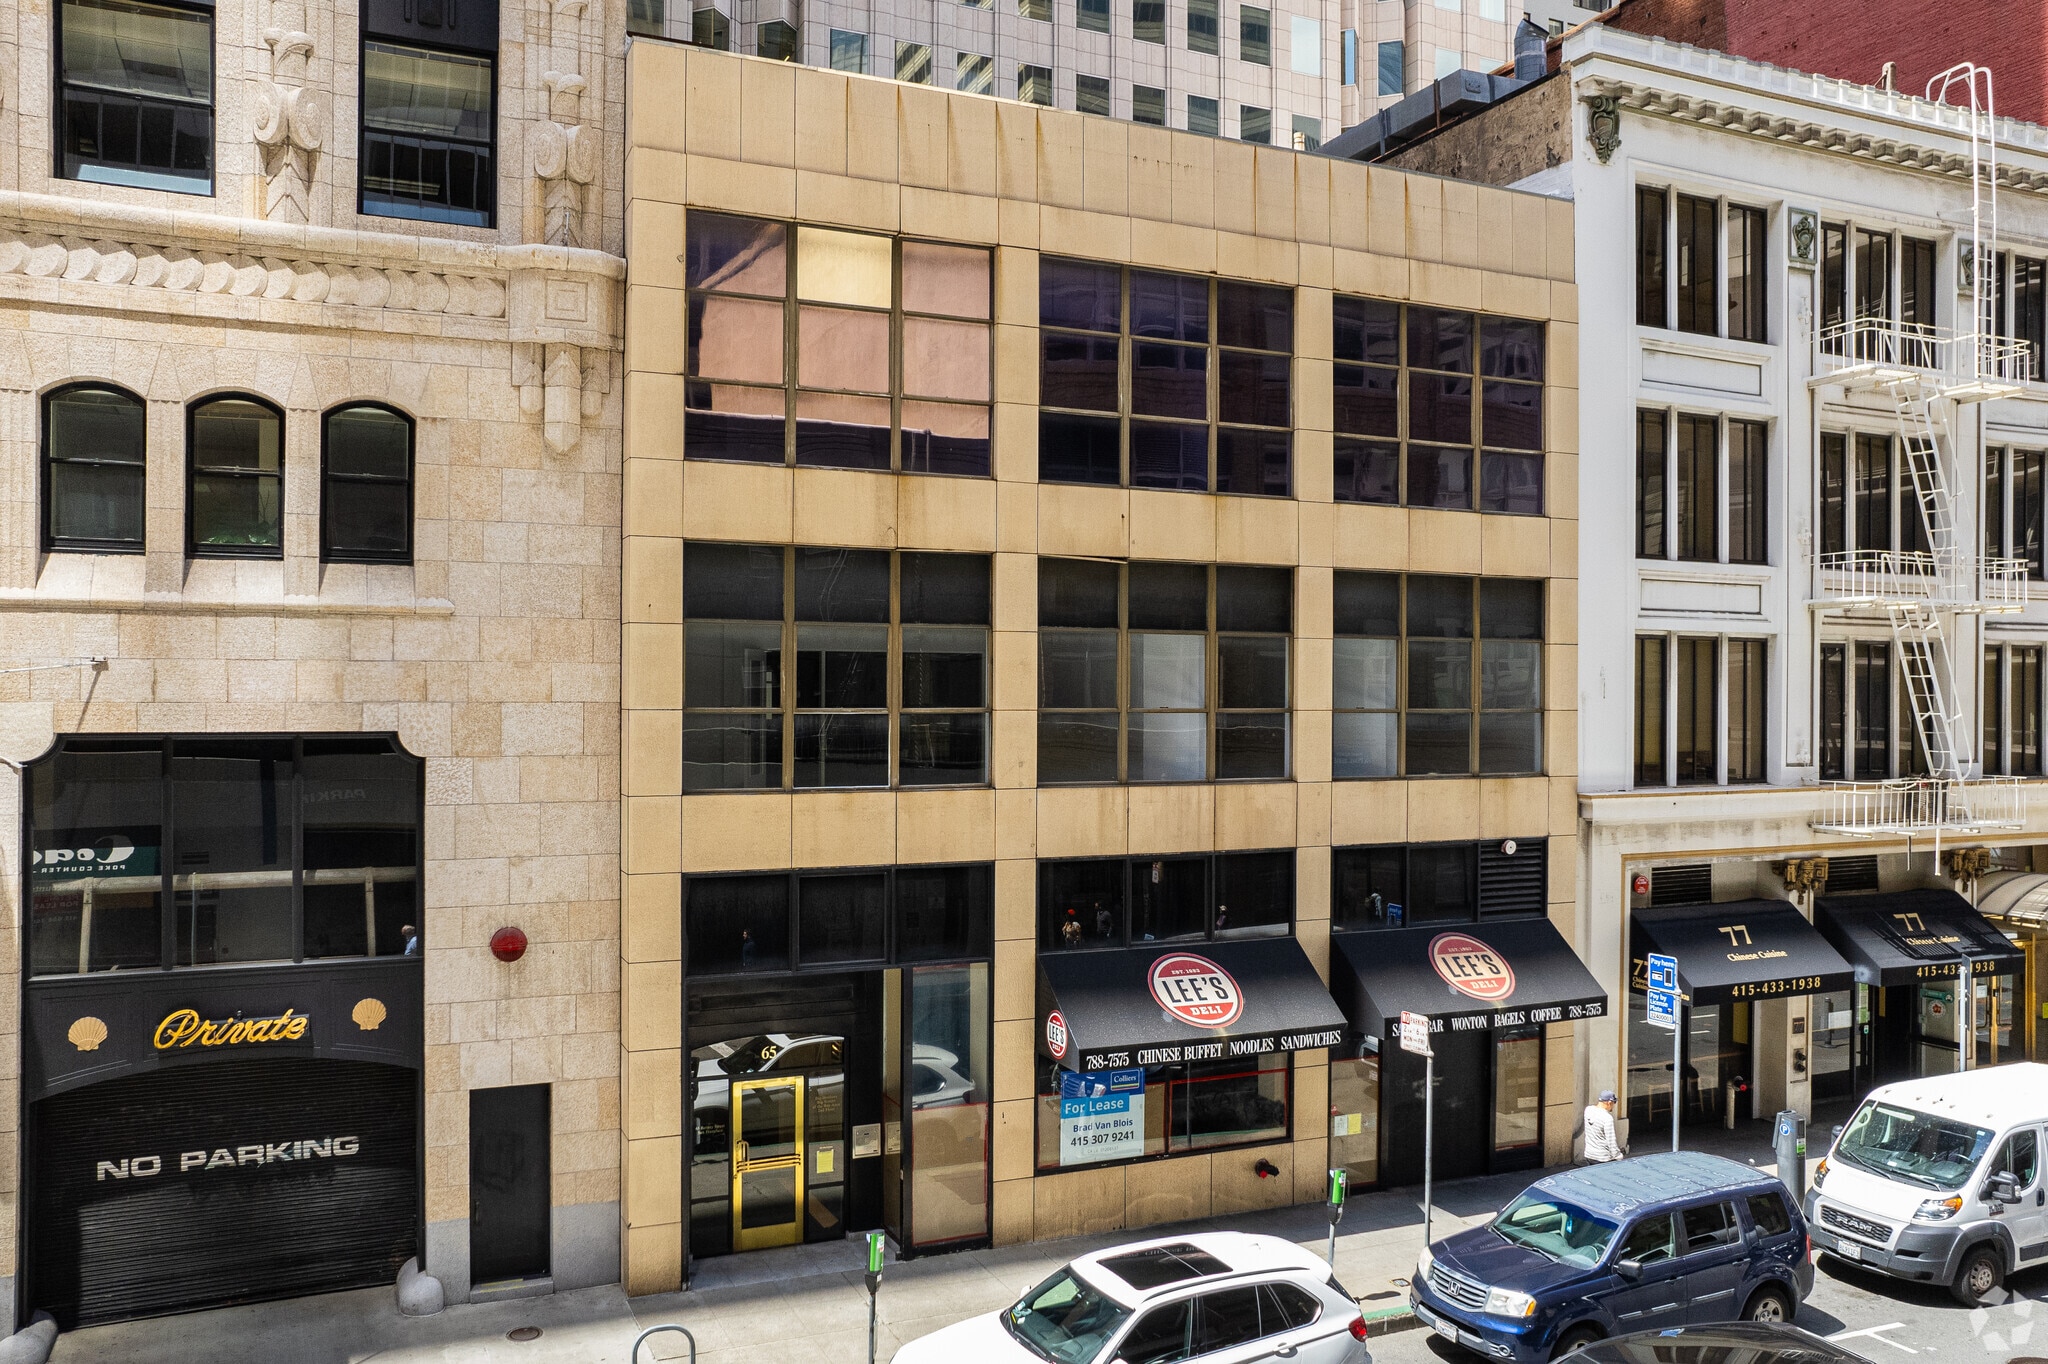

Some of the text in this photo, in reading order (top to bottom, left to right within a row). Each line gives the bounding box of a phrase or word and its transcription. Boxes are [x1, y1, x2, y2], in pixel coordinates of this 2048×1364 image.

[1893, 912, 1926, 932] 77
[1718, 925, 1753, 947] 77
[1650, 957, 1675, 968] Pay here
[1727, 949, 1788, 962] Chinese Cuisine
[1441, 954, 1501, 978] LEE'S
[1161, 976, 1229, 1003] LEE'S
[1470, 980, 1499, 989] DELI
[1732, 976, 1821, 997] 415-433-1938
[1190, 1005, 1224, 1016] DELI
[1451, 1015, 1488, 1031] WONTON
[1494, 1011, 1526, 1027] BAGELS
[1531, 1007, 1562, 1023] COFFEE
[1568, 1003, 1602, 1018] 788-7575
[153, 1008, 308, 1049] Private
[761, 1046, 777, 1060] 65
[1086, 1030, 1341, 1069] 788-7575 CHINESE BUFFET NOODLES SANDWICHES
[1113, 1074, 1136, 1083] Colliers
[1065, 1099, 1124, 1114] For Lease
[1073, 1118, 1133, 1132] Brad Van Blois
[1070, 1130, 1134, 1146] 415 307 9241
[97, 1136, 360, 1181] NO PARKING
[1836, 1215, 1872, 1232] RAM
